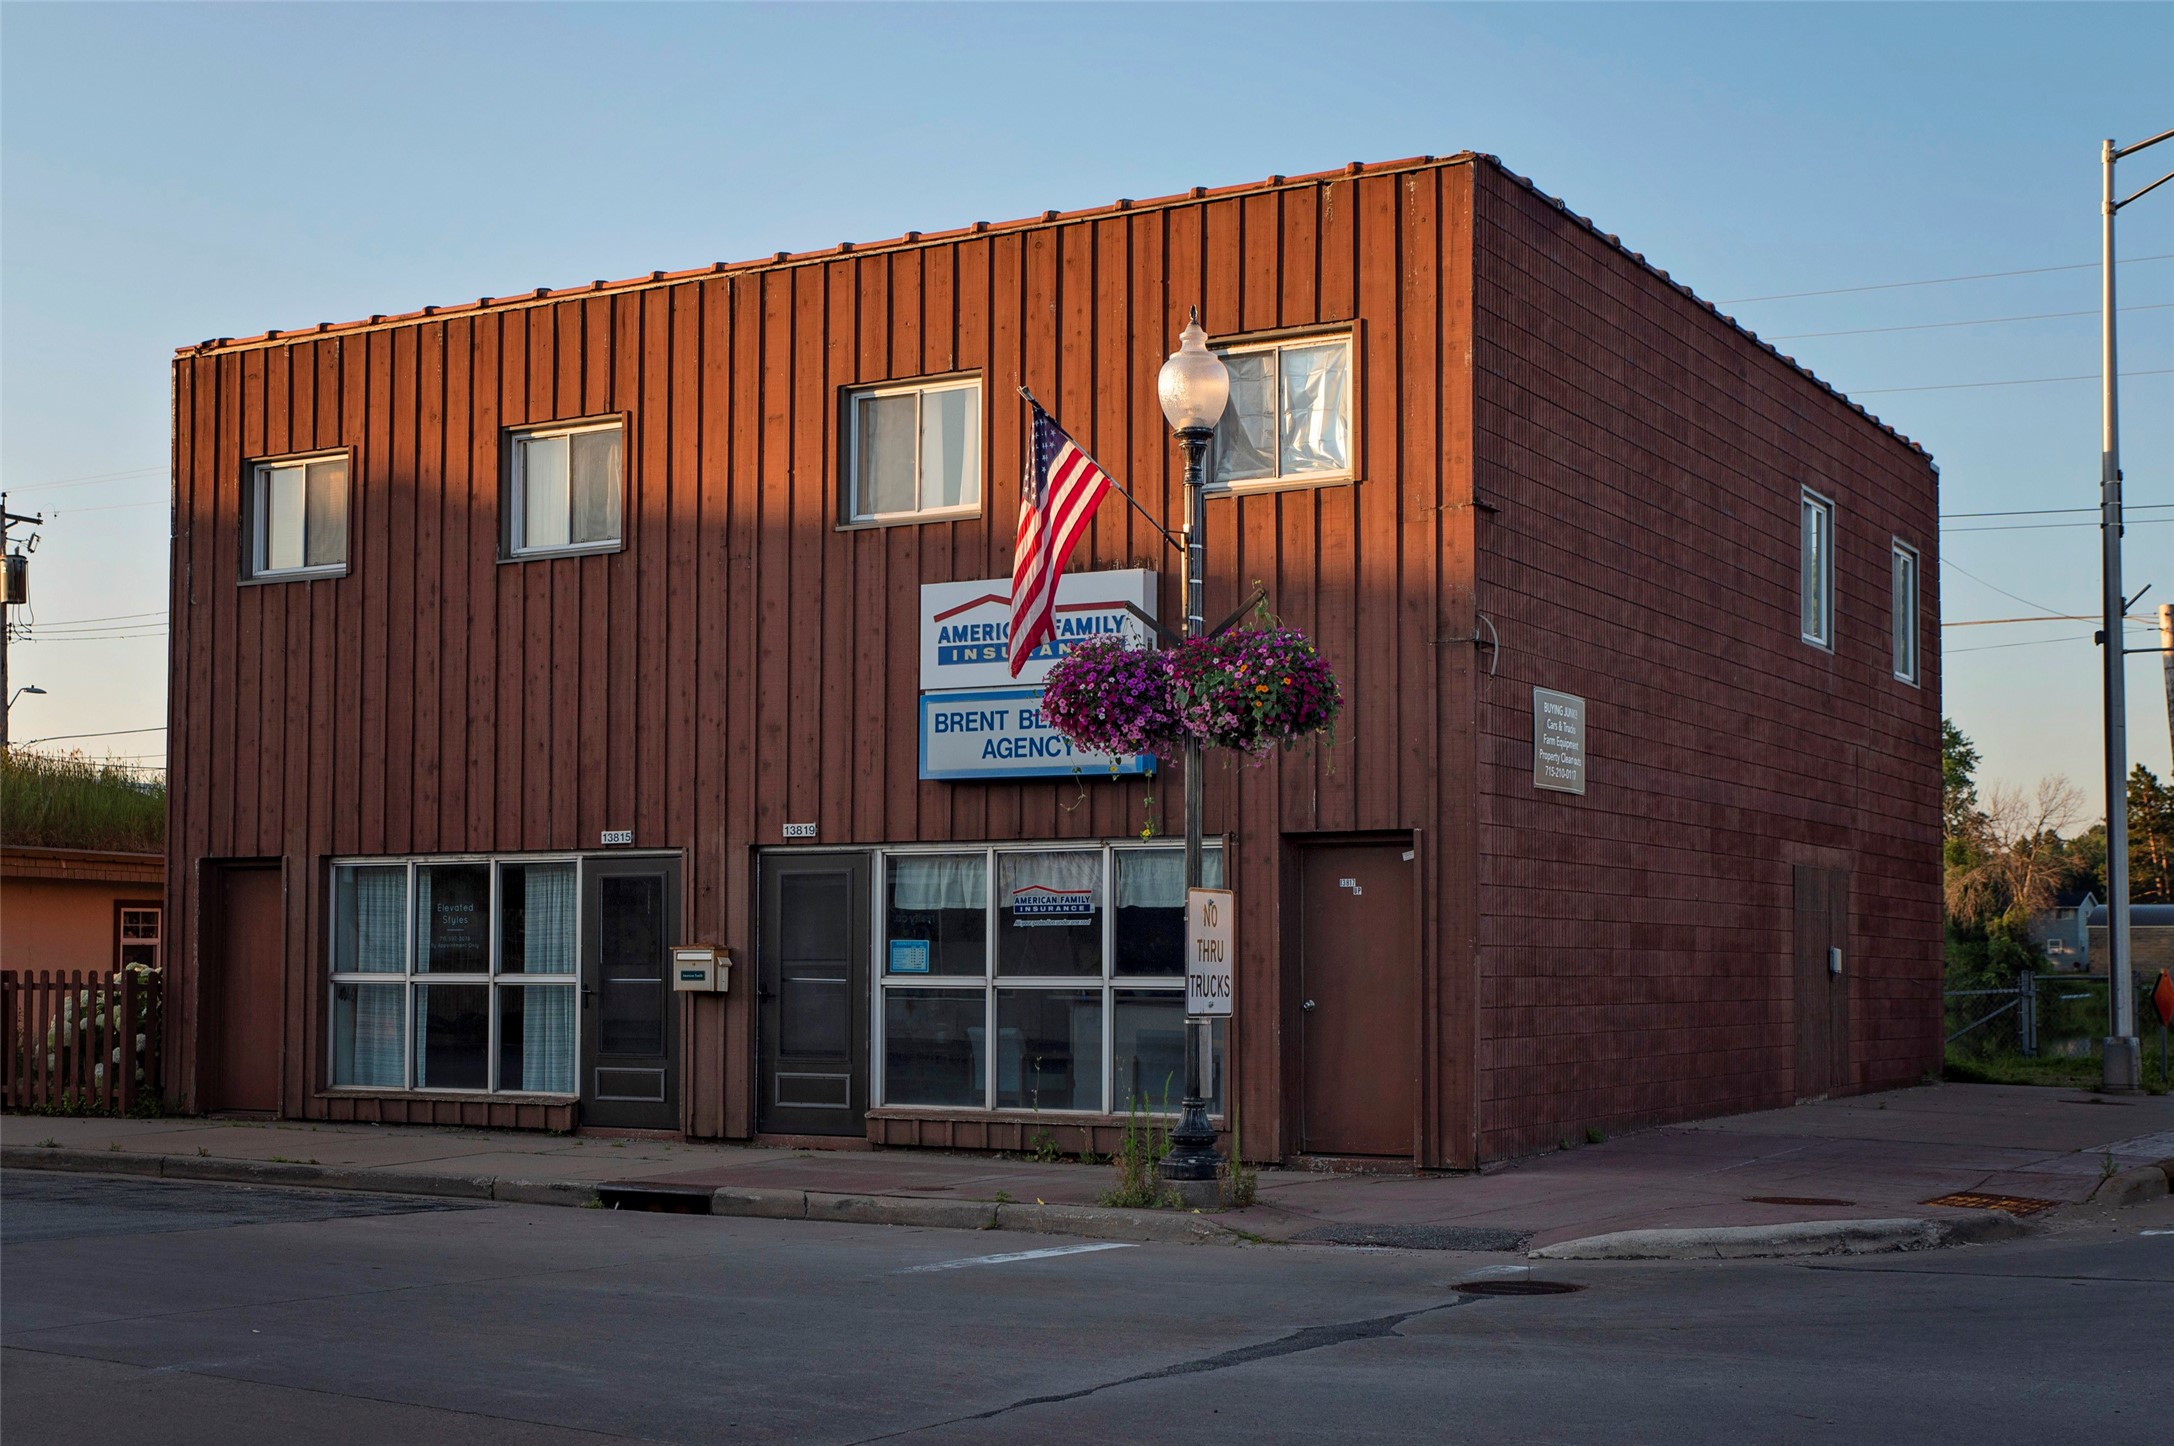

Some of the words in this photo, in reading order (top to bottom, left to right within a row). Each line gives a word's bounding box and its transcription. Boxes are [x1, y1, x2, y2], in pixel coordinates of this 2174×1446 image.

[1544, 702, 1563, 717] BUYING
[934, 709, 1009, 733] BRENT
[1546, 718, 1558, 731] Cars
[1558, 721, 1563, 731] &
[1563, 721, 1576, 735] Trucks
[981, 735, 1073, 760] AGENCY
[1543, 733, 1556, 746] Farm
[1556, 736, 1579, 751] Equipment
[1539, 748, 1560, 765] Property
[602, 832, 631, 842] 13815
[784, 825, 815, 836] 13819
[437, 903, 474, 912] Elevated
[1014, 896, 1058, 905] AMERICAN
[1060, 895, 1091, 904] FAMILY
[442, 915, 469, 925] Styles
[1203, 903, 1218, 928] NO
[1196, 938, 1224, 963] THRU
[1190, 973, 1231, 998] TRUCKS
